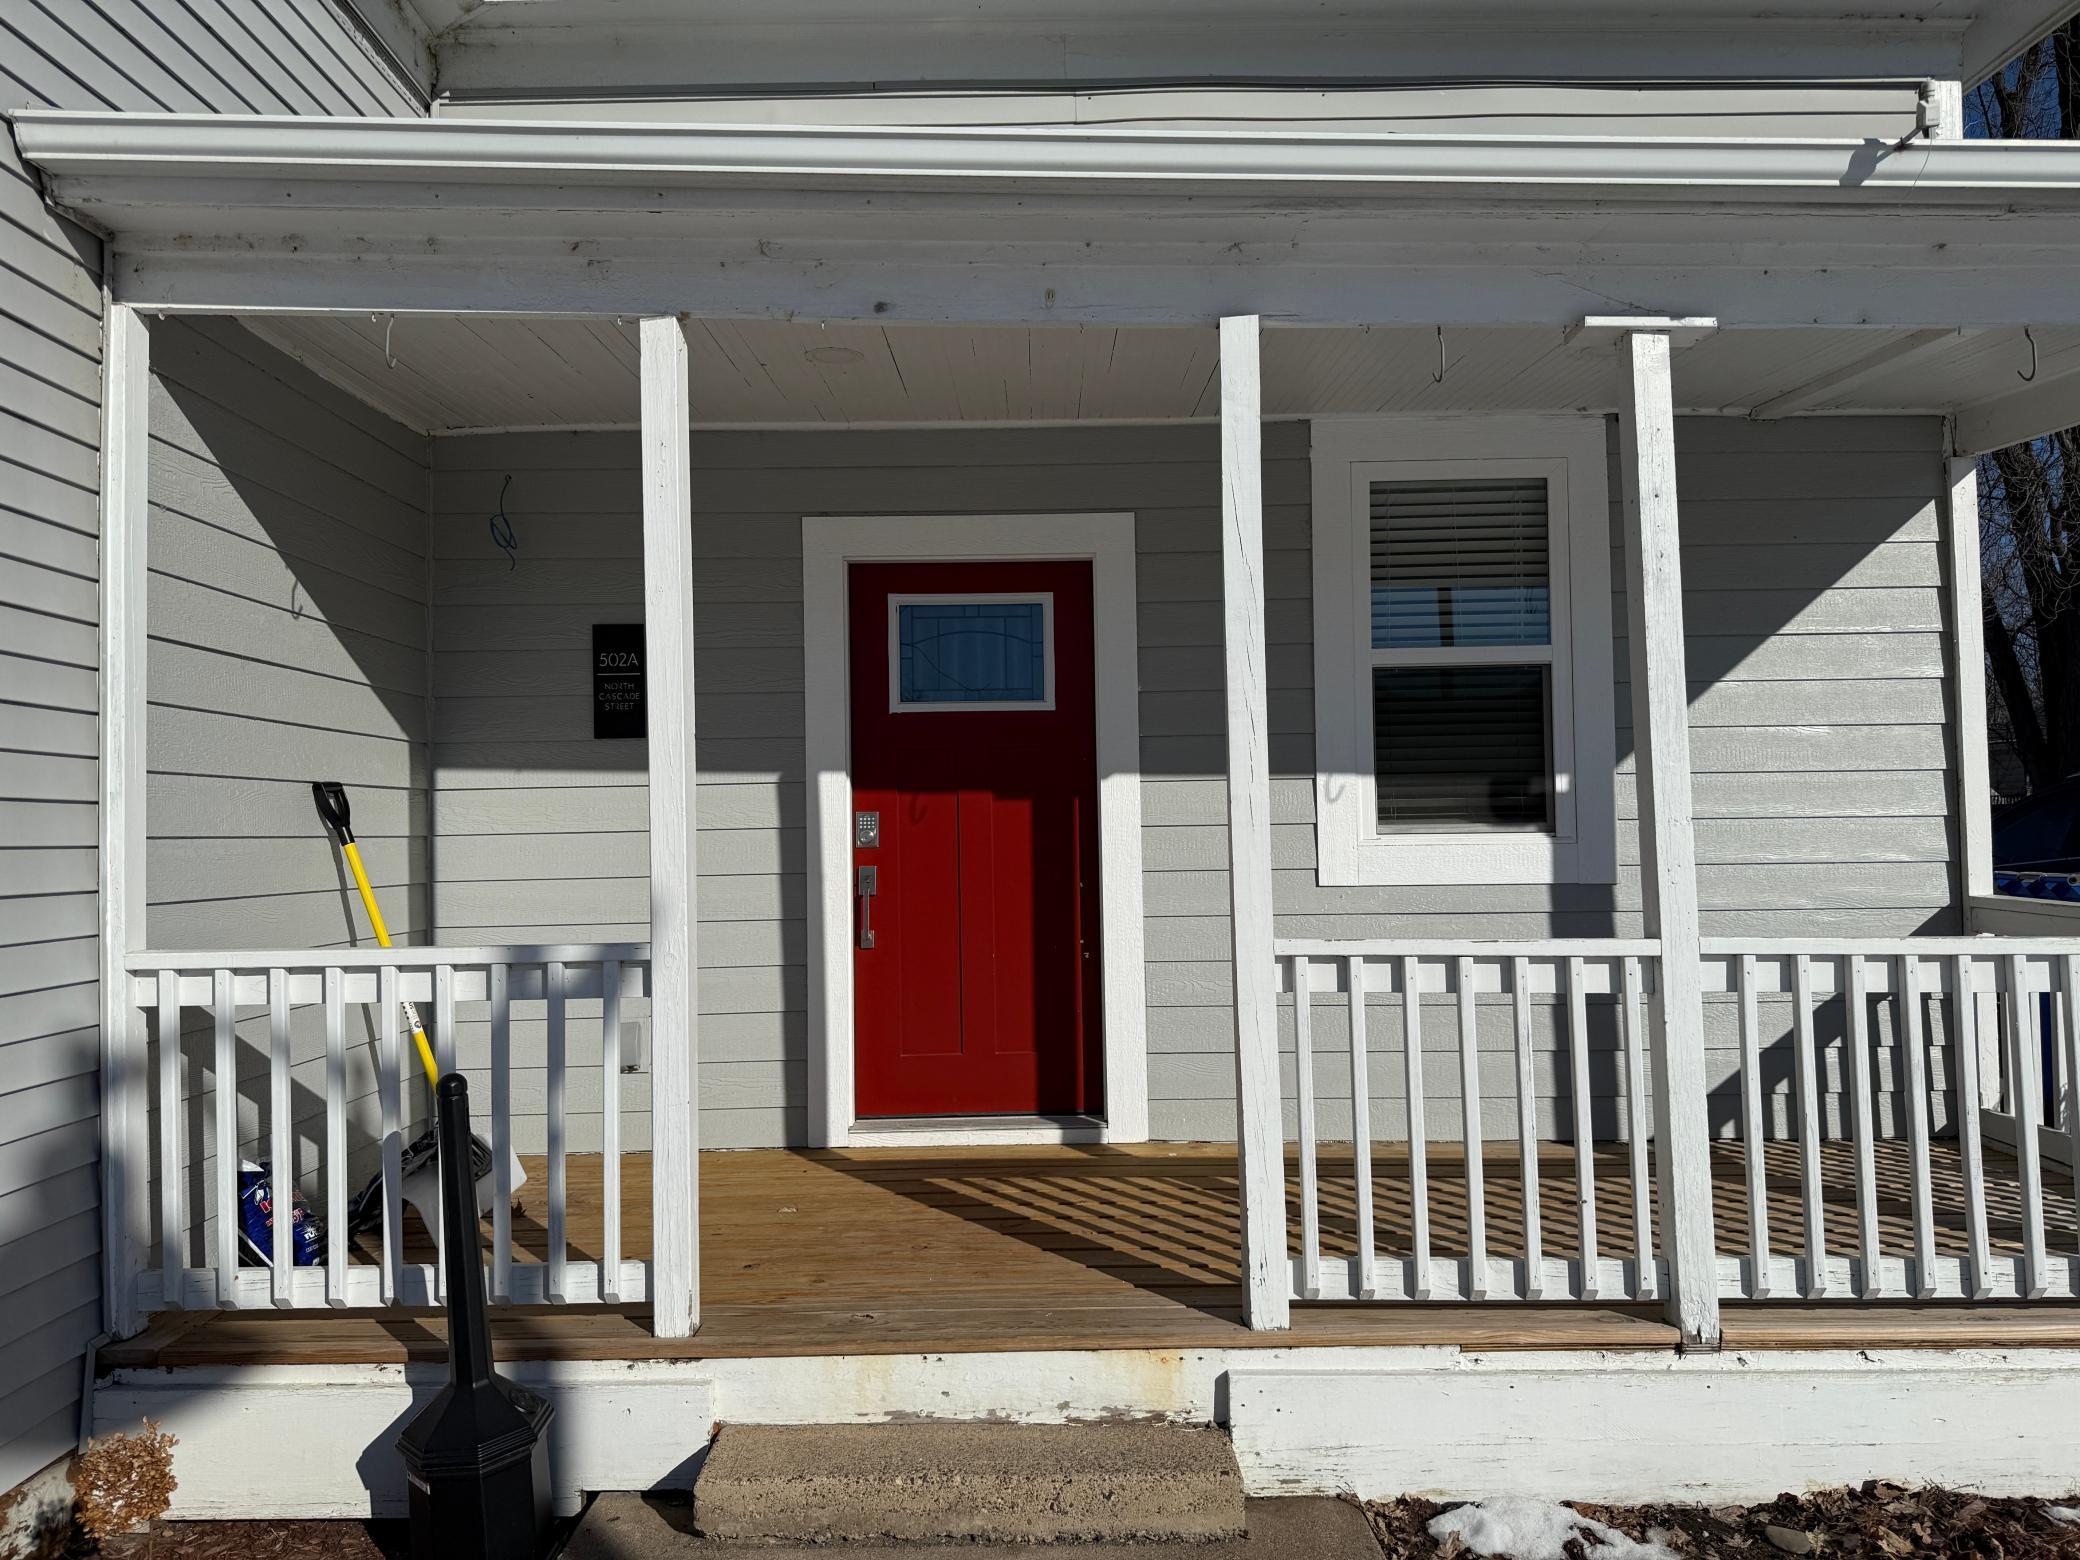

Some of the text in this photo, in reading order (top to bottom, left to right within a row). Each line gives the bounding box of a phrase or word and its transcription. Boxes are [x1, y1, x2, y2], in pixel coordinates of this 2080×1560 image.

[599, 653, 639, 667] 502A
[604, 682, 634, 690] NORTH
[598, 692, 640, 701] CASCADE
[604, 702, 634, 711] STREET
